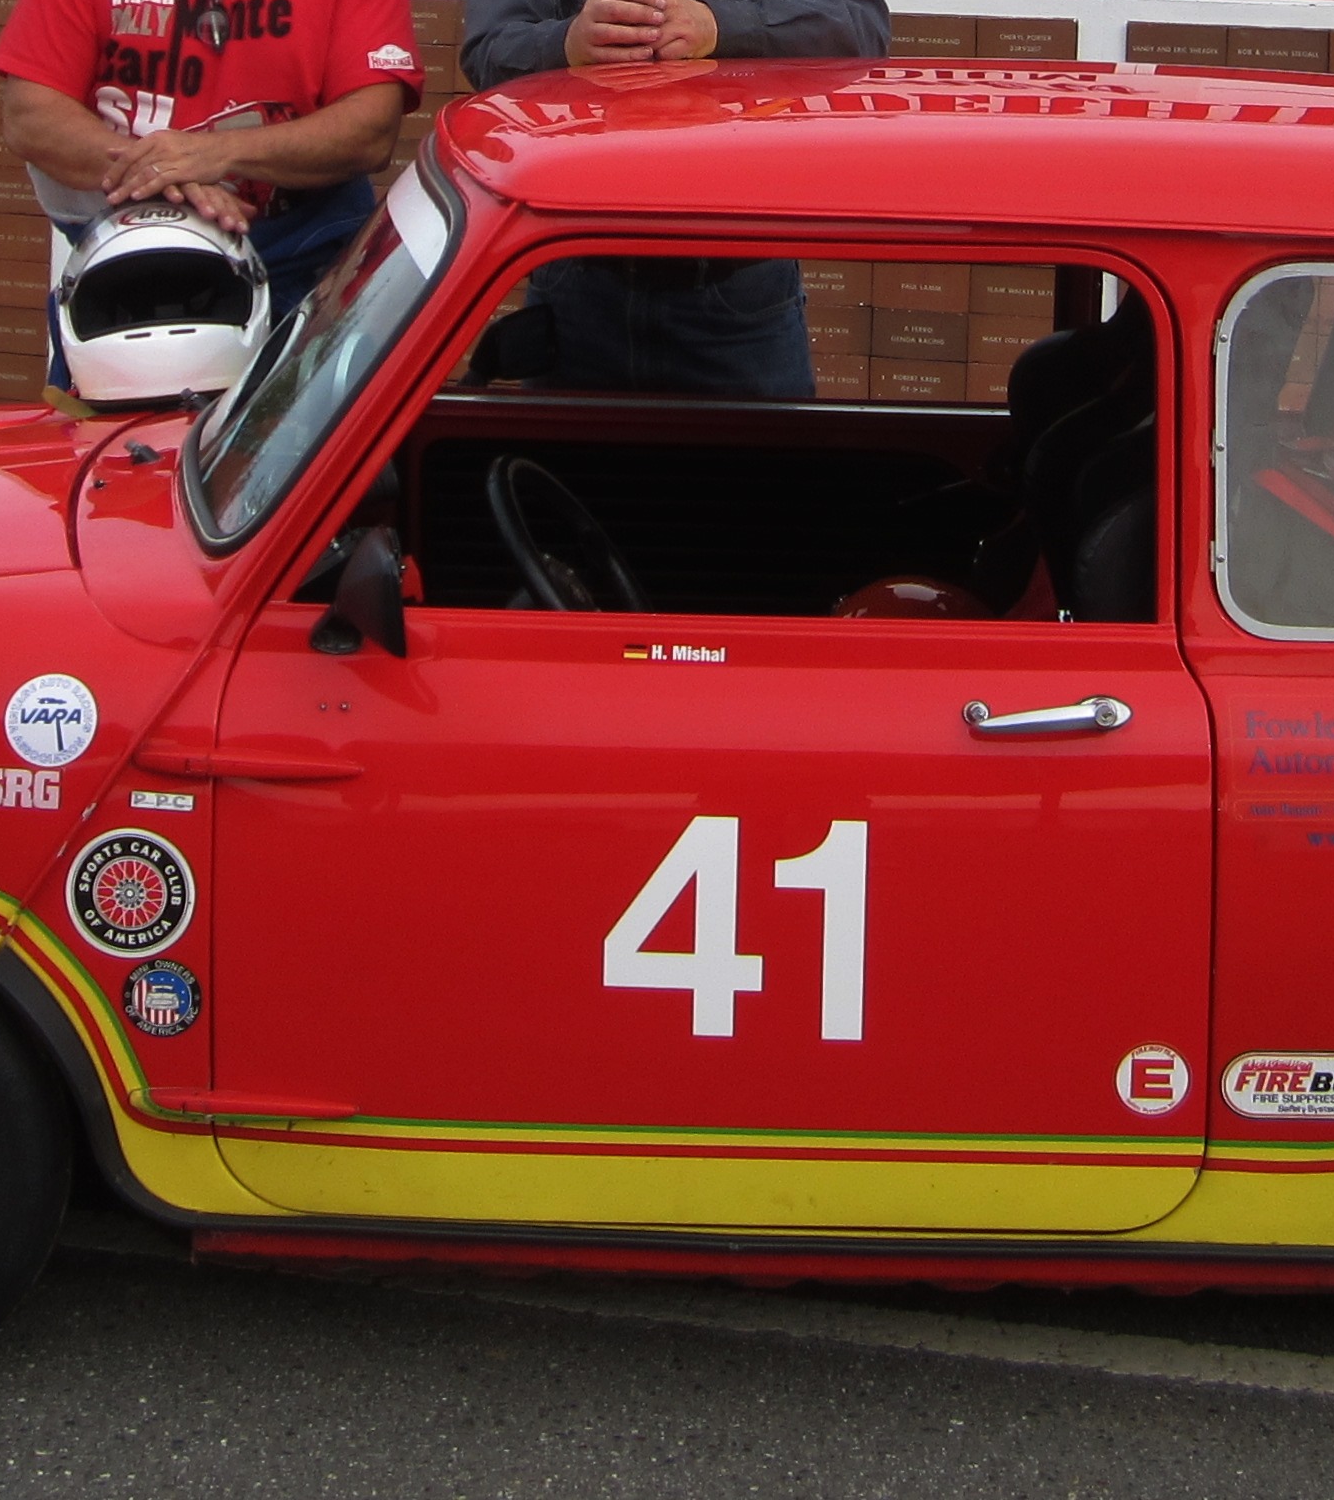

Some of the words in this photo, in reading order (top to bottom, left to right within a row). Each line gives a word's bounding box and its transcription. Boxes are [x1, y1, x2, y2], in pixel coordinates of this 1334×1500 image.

[651, 645, 667, 660] H.
[672, 645, 726, 662] Mishal
[79, 842, 123, 893] SPORTS
[130, 841, 161, 863] CAR
[164, 864, 182, 906] CLUB
[84, 909, 102, 927] OF
[104, 919, 172, 945] AMERICA
[603, 815, 868, 1041] 41
[129, 963, 149, 983] MINI
[154, 959, 196, 986] OWNERS
[125, 1004, 135, 1018] OF
[136, 1019, 185, 1036] AMERICA
[1130, 1059, 1174, 1099] E
[1252, 1094, 1279, 1104] FIRE
